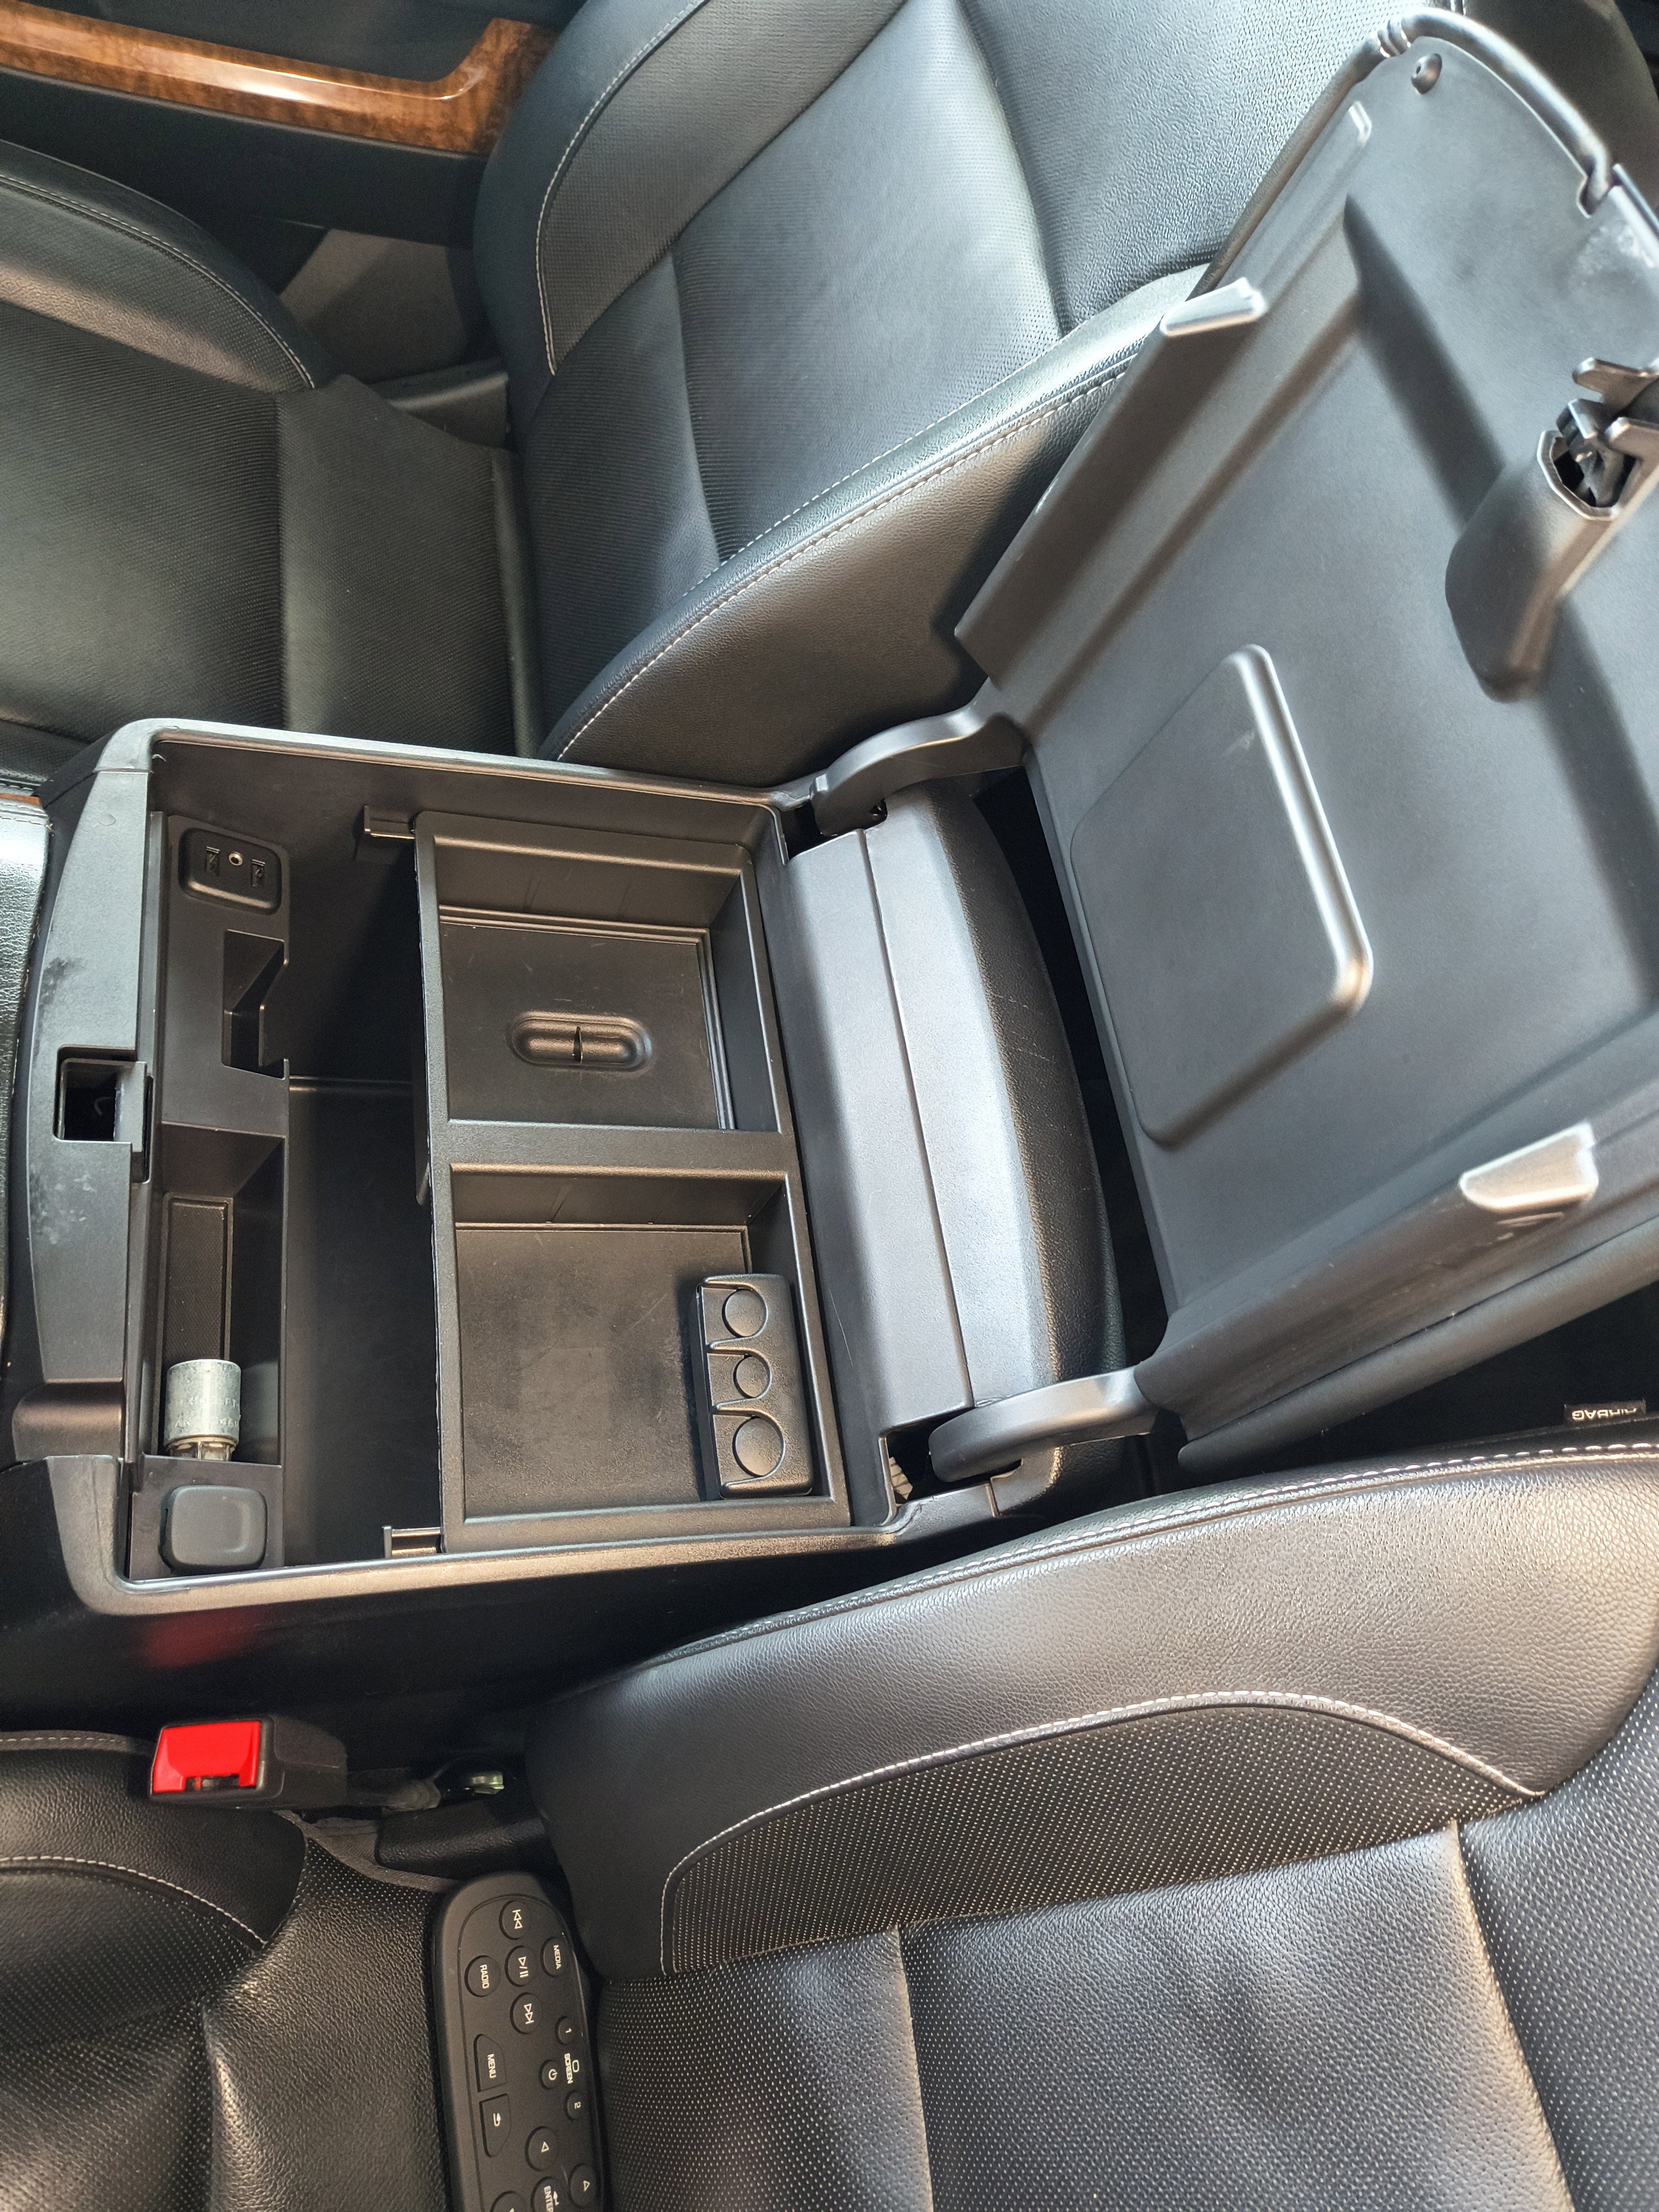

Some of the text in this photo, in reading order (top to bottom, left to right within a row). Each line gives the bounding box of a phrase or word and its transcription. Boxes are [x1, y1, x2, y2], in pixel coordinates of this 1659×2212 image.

[553, 1945, 561, 1969] MEDIA
[480, 1964, 489, 1988] RADIO
[488, 2053, 496, 2078] MENU
[564, 2053, 573, 2083] SCREEN
